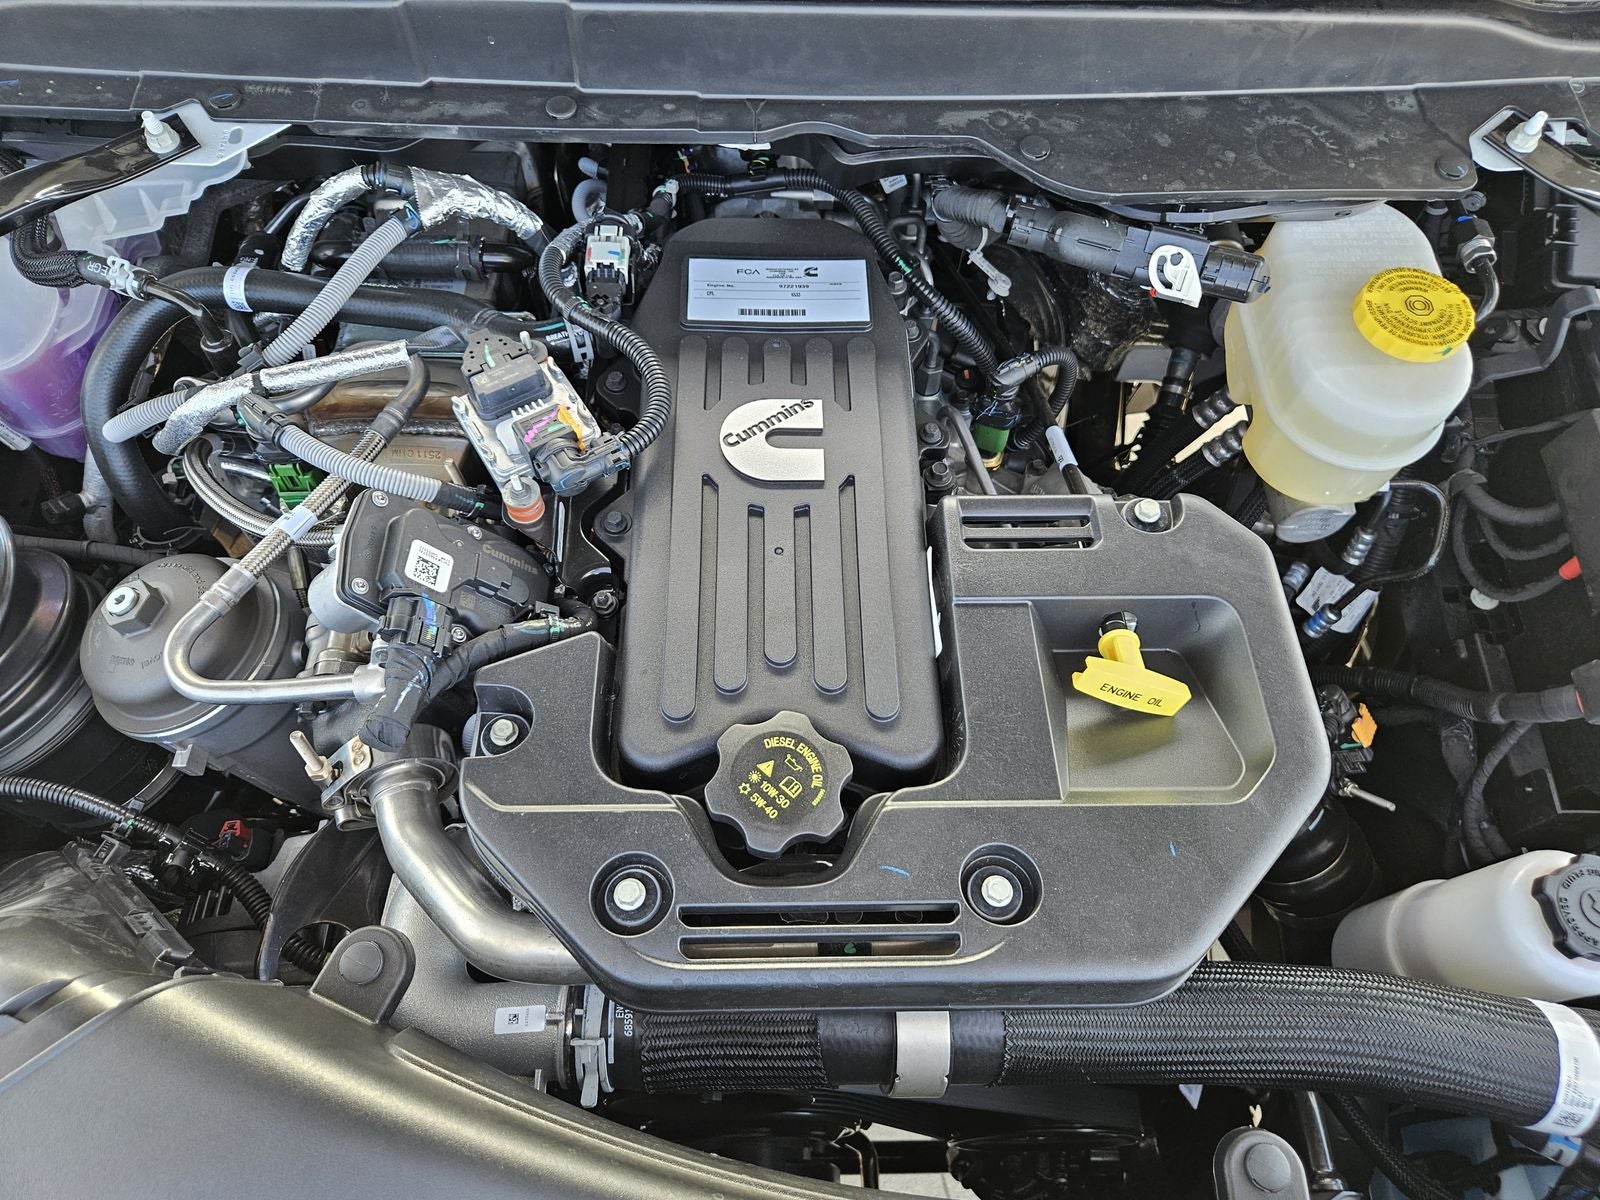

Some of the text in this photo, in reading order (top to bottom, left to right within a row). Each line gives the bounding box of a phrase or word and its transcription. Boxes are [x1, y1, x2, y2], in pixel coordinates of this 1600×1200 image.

[88, 260, 109, 276] EGR
[722, 399, 814, 448] Cummins
[482, 544, 538, 575] Cummins
[1100, 682, 1162, 708] ENGINE OIL
[764, 736, 796, 750] DIESEL
[796, 743, 823, 774] ENGINE
[811, 774, 824, 789] OIL
[750, 793, 778, 819] 5W-40
[760, 781, 790, 809] 10W-30
